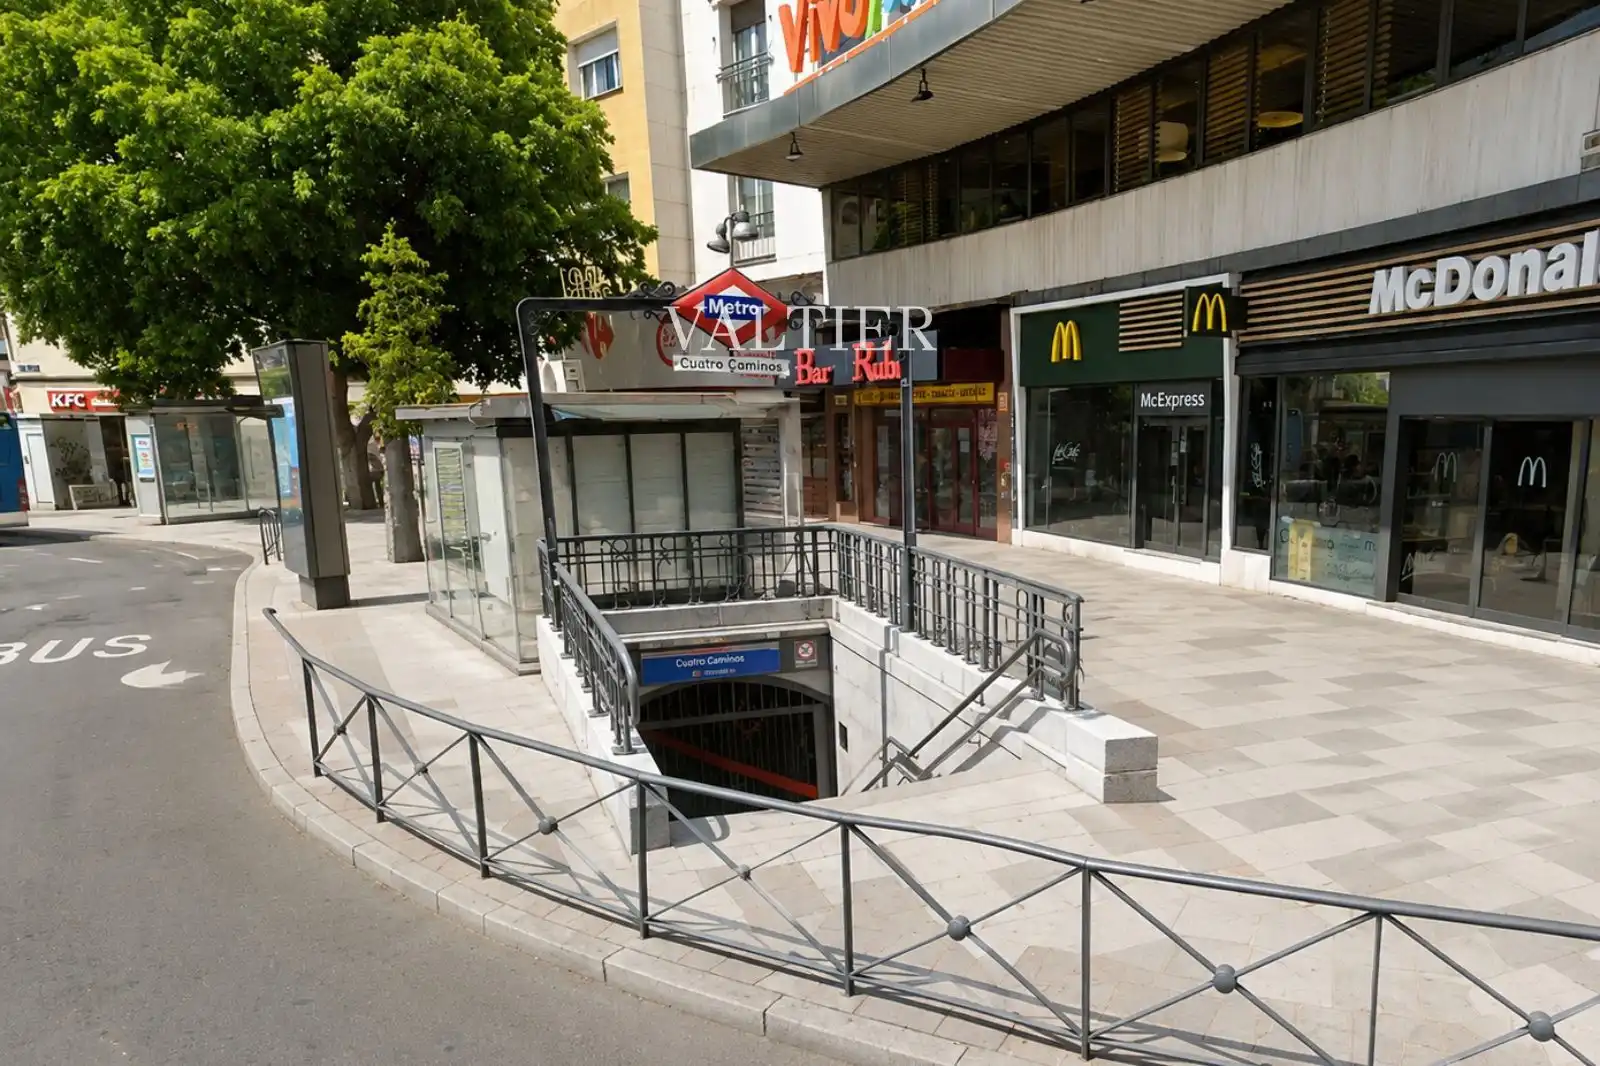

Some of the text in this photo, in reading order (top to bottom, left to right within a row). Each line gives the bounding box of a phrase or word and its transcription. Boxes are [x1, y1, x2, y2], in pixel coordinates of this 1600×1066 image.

[1369, 228, 1600, 314] McDonal
[708, 298, 758, 315] Metro
[680, 357, 783, 373] Cuatro Caminos
[794, 348, 832, 385] Bar
[51, 393, 86, 407] KFC
[1140, 392, 1205, 412] McExpress
[0, 634, 152, 665] BUS
